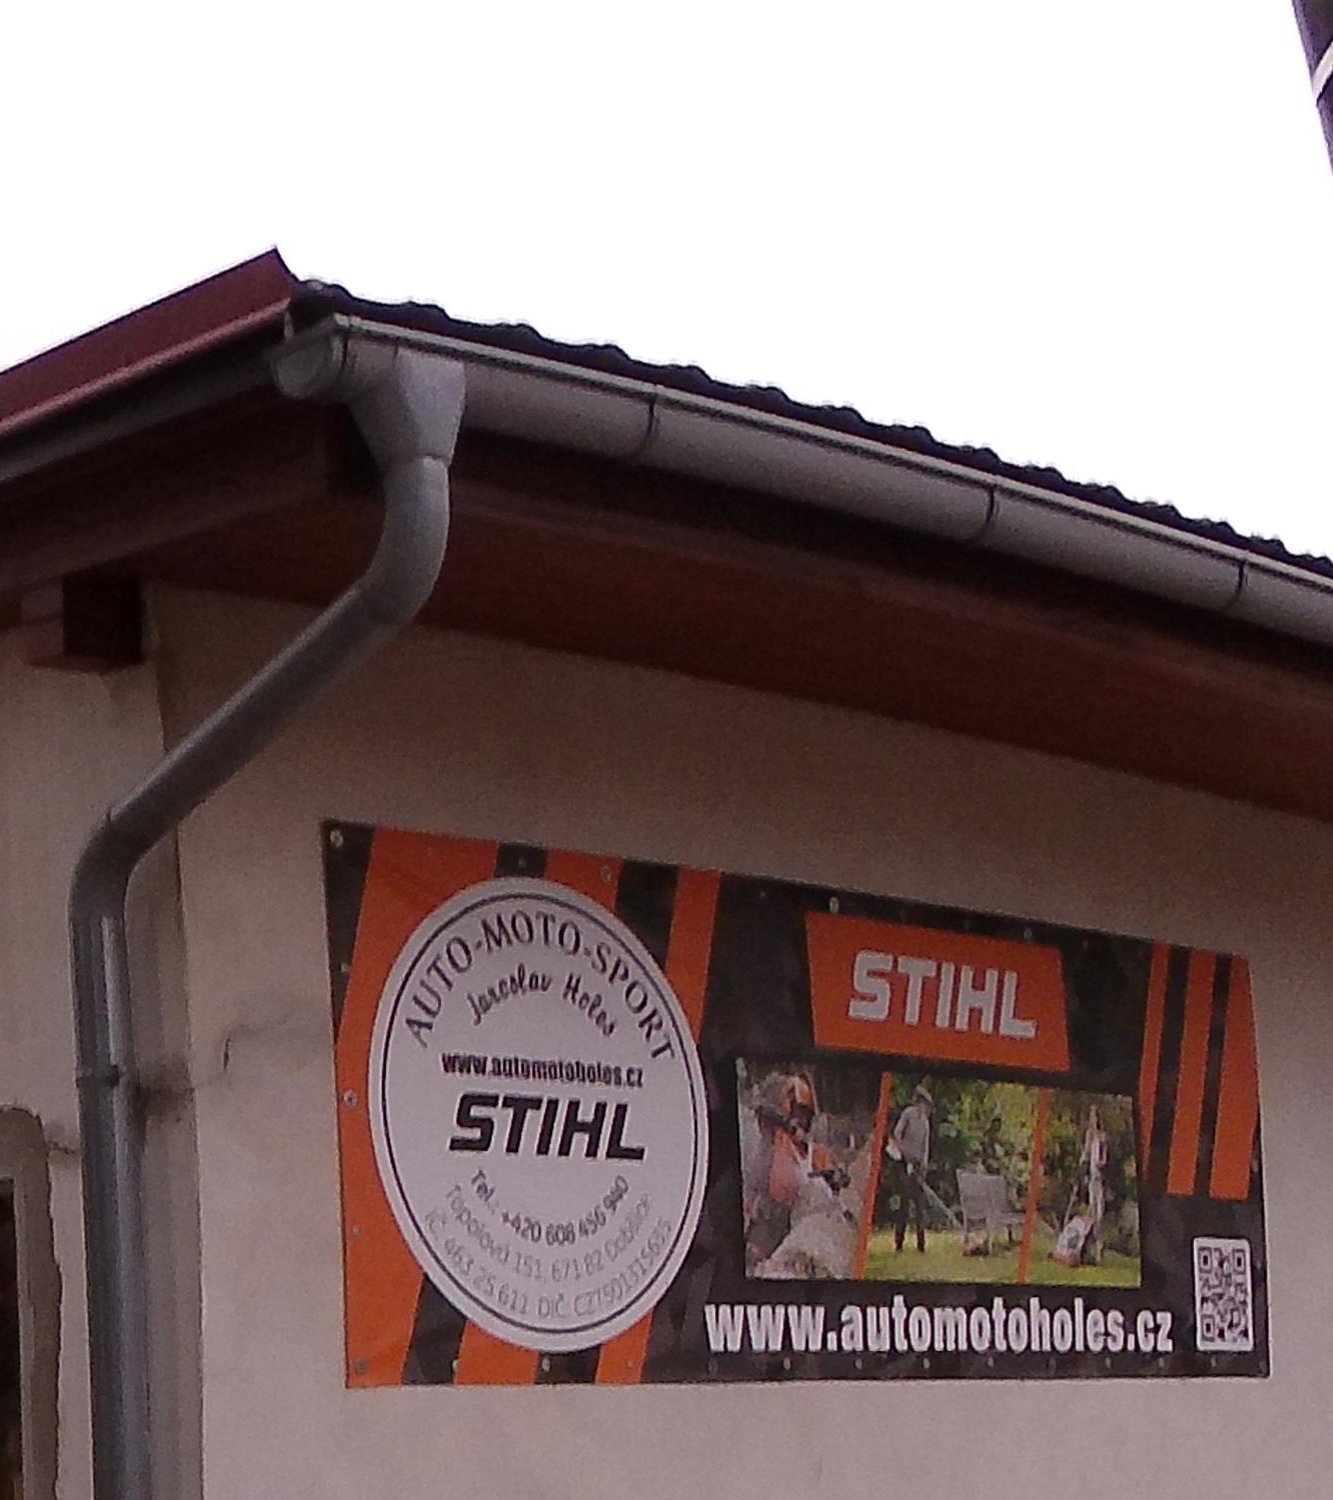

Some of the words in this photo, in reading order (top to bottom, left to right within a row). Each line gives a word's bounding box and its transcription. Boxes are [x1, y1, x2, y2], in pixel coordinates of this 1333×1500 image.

[405, 909, 676, 1060] AUTO-MOTO-SPORT
[847, 948, 1038, 1040] STIHL
[441, 1052, 644, 1088] www.automotoholes.cz
[448, 1091, 646, 1160] STIHL
[545, 1221, 576, 1246] 608
[704, 1294, 1174, 1354] www.automotoholes.cz
